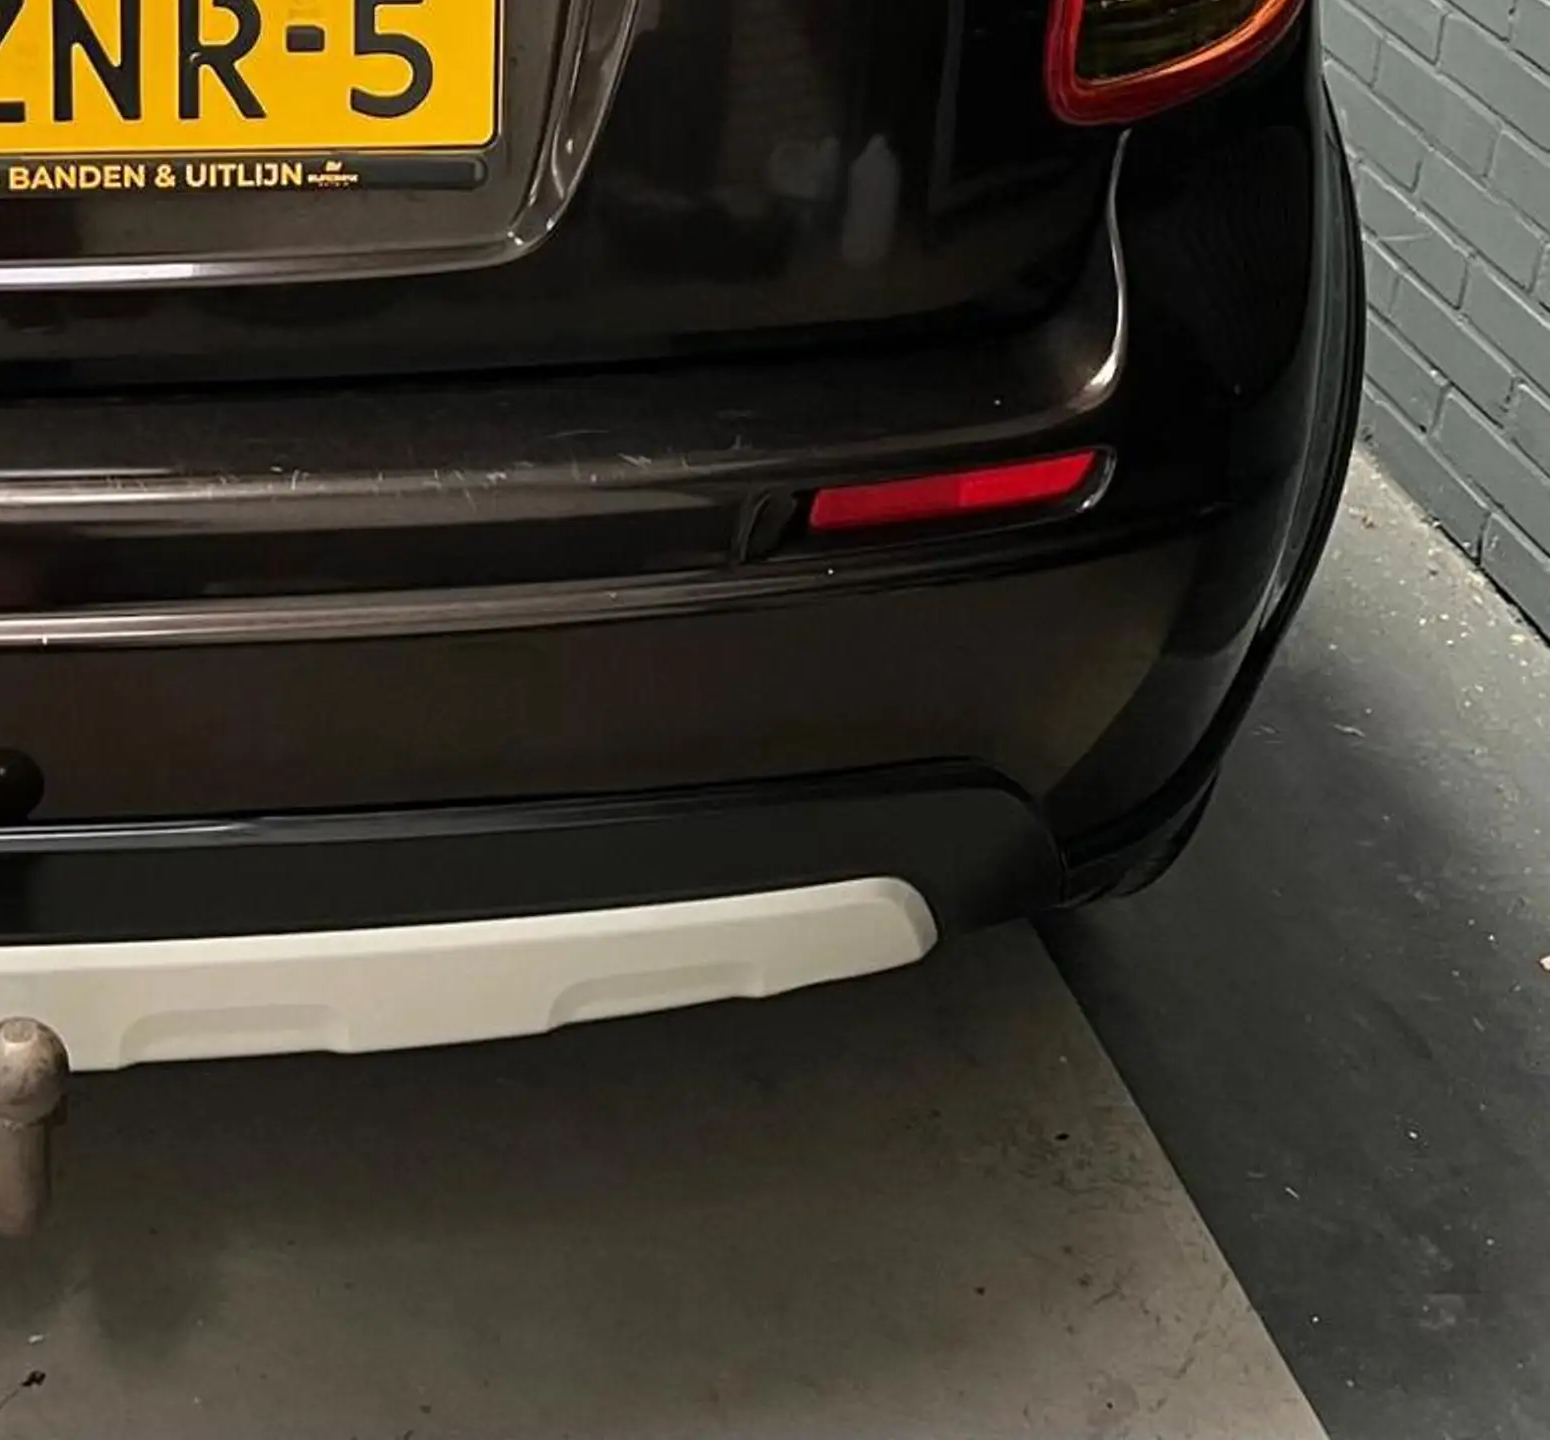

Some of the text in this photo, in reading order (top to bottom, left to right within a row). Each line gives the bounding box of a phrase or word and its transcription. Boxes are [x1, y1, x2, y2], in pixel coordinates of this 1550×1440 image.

[9, 164, 145, 190] BANDEN
[154, 163, 176, 188] &
[185, 162, 302, 187] UITLIJN
